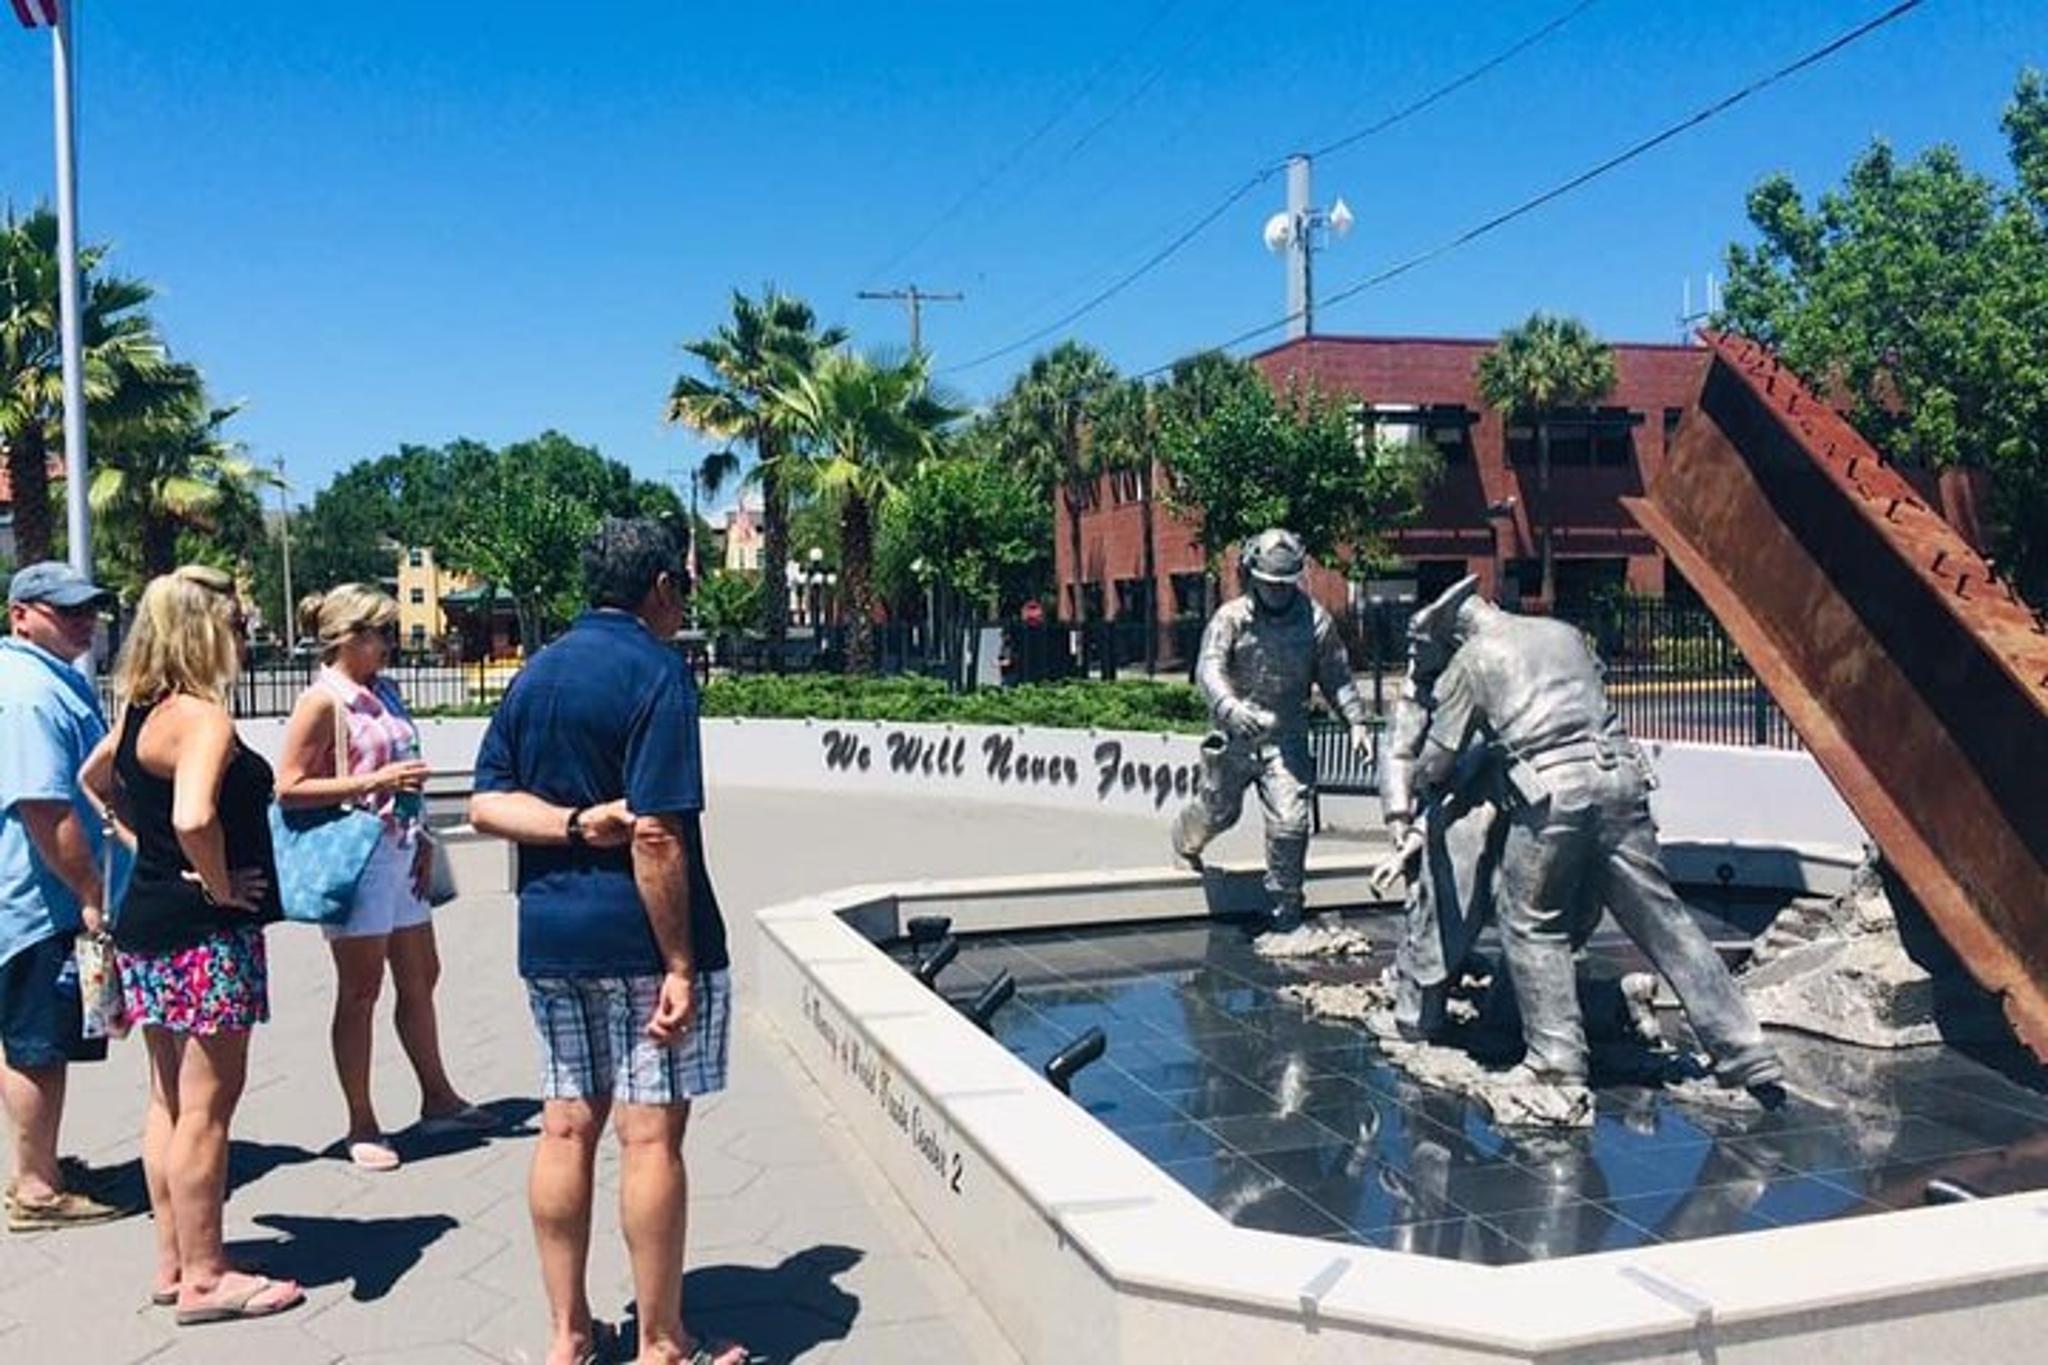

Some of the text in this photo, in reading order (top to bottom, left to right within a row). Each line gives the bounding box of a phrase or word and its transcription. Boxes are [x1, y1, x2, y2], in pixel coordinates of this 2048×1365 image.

[822, 729, 871, 772] We
[887, 731, 966, 777] Will
[982, 733, 1078, 785] Never
[950, 1152, 963, 1194] 2
